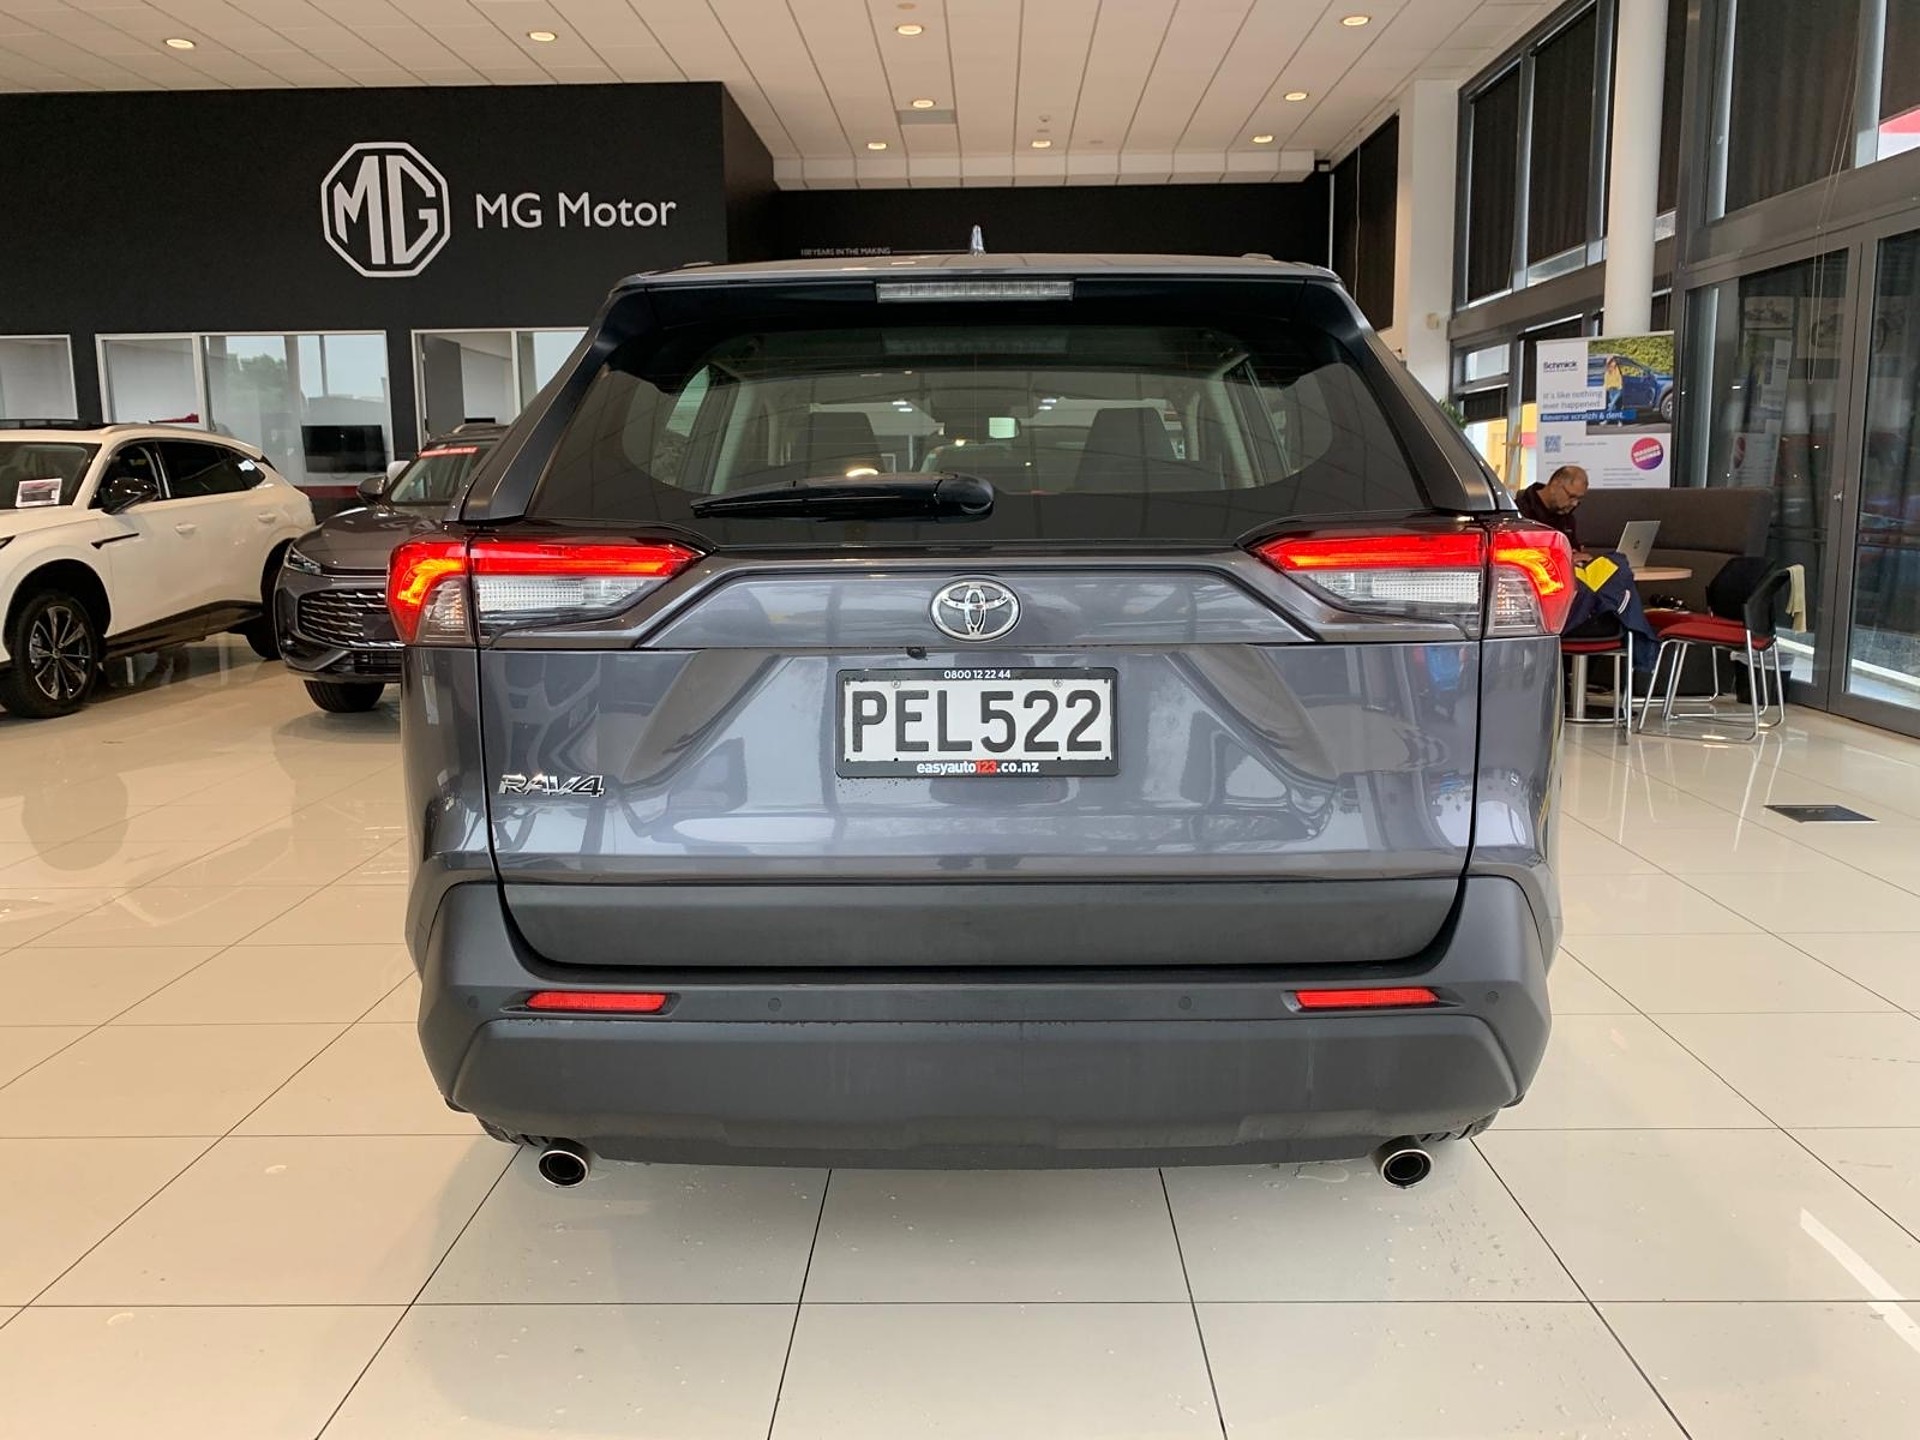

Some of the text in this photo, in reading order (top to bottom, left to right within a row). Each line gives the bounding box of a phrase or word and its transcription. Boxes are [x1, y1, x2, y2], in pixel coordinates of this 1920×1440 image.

[333, 155, 438, 265] MG
[475, 191, 677, 229] MG Motor
[814, 248, 835, 256] YEARS
[844, 247, 859, 255] THE
[860, 247, 891, 255] MAKING
[1543, 361, 1578, 369] Schmick
[1557, 391, 1570, 399] like
[1572, 390, 1603, 400] nothing
[1542, 413, 1570, 421] Reverse
[1571, 412, 1598, 420] scratch
[944, 669, 1011, 680] 0800 12 22 44
[852, 689, 1102, 752] PEL522
[916, 760, 1039, 775] easyauto123.co.nz
[499, 772, 605, 798] RAV4
